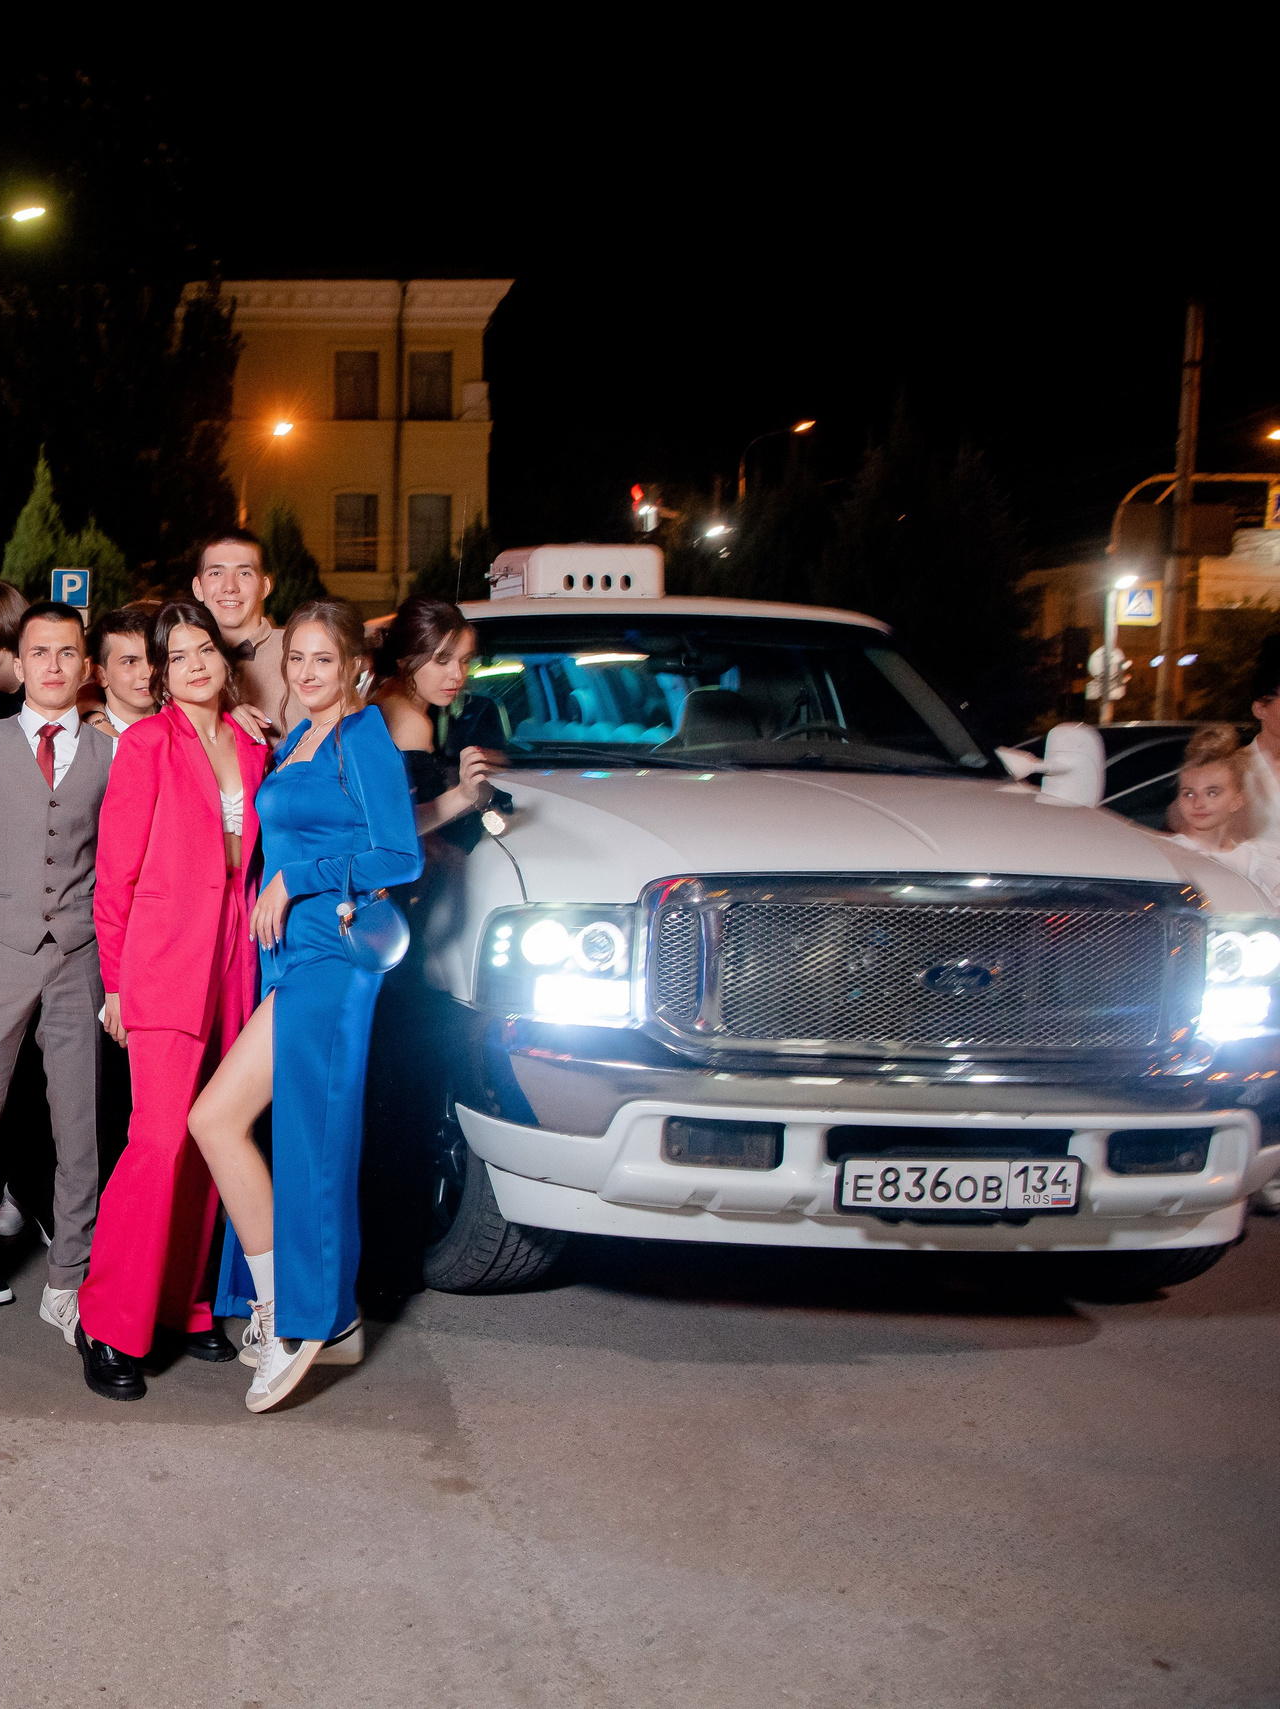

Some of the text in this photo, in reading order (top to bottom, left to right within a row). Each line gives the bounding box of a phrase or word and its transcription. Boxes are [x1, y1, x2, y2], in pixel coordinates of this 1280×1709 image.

[62, 573, 82, 603] P
[1013, 1165, 1068, 1194] 134
[1022, 1194, 1051, 1205] RUS
